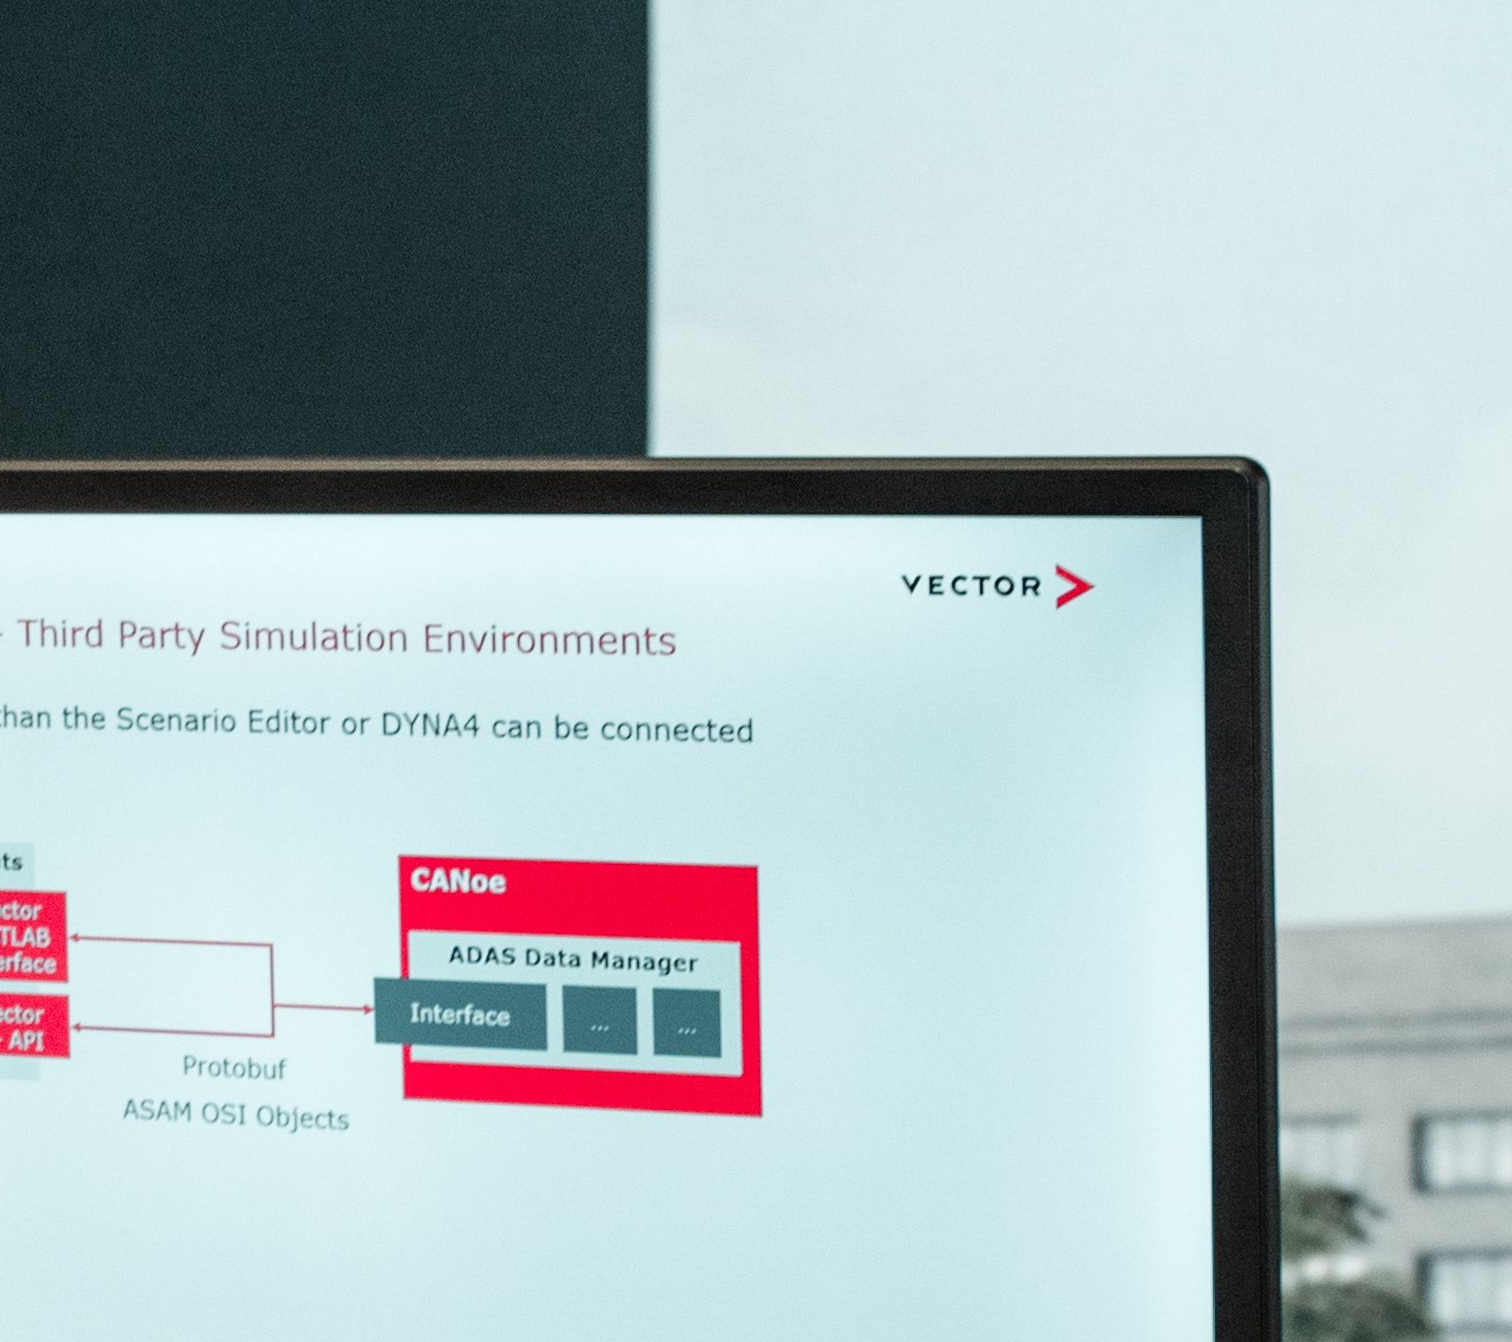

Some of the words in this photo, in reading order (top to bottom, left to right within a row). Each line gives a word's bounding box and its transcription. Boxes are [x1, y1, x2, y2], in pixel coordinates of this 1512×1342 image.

[901, 575, 1042, 597] VECTOR
[18, 617, 103, 649] Third
[118, 619, 205, 655] Party
[219, 622, 409, 655] Simulation
[423, 624, 677, 658] Environments
[62, 705, 105, 730] the
[116, 706, 236, 733] Scenario
[247, 710, 331, 736] Editor
[341, 717, 370, 735] or
[381, 712, 480, 739] DYNA4
[491, 719, 542, 740] can
[555, 715, 589, 741] be
[600, 717, 754, 744] connected
[410, 867, 507, 896] CANoe
[448, 945, 517, 969] ADAS
[524, 947, 582, 971] Data
[591, 949, 700, 977] Manager
[410, 1002, 511, 1028] Interface
[7, 1030, 45, 1053] API
[183, 1055, 286, 1081] Protobuf
[123, 1100, 193, 1125] ASAM
[201, 1102, 248, 1127] OSI
[256, 1103, 351, 1134] Objects
